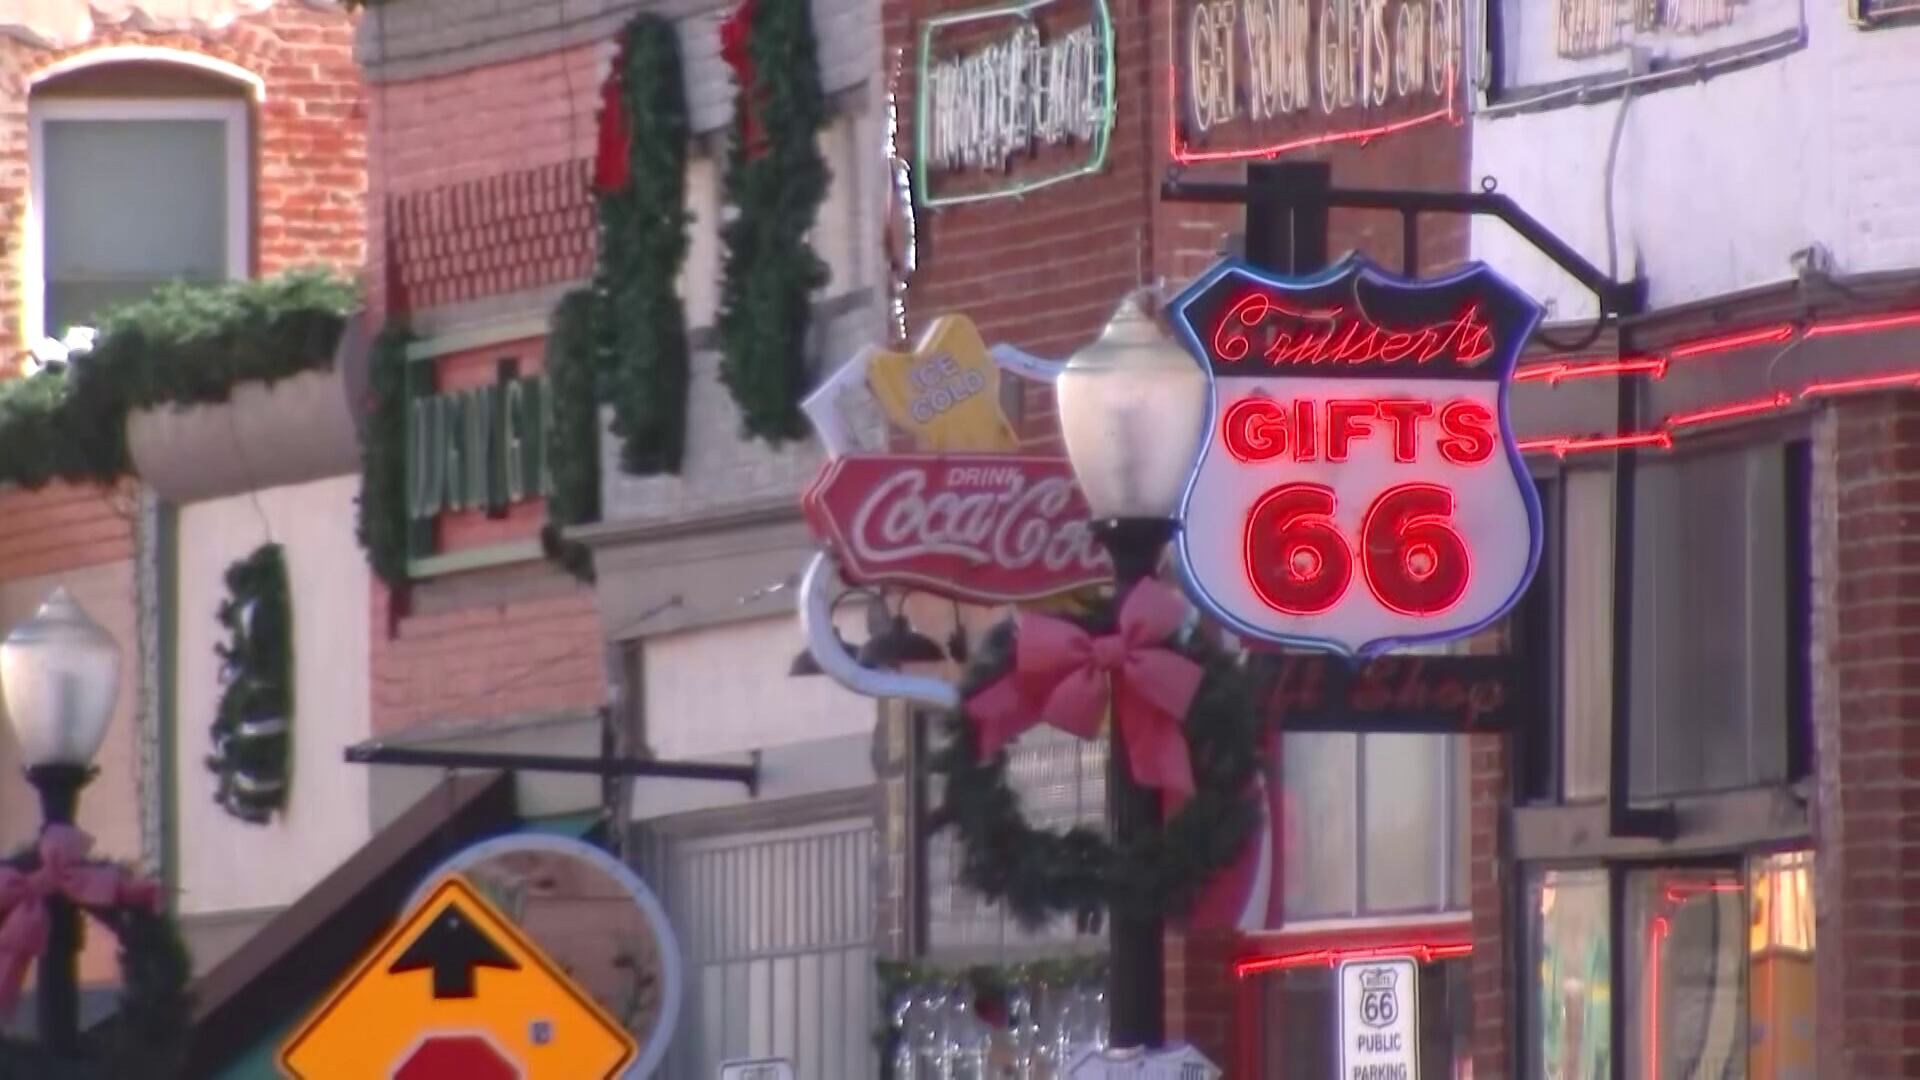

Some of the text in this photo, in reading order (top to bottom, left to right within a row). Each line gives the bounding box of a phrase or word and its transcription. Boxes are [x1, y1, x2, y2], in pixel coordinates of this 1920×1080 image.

[1190, 2, 1239, 131] GET
[1319, 0, 1391, 114] GIFTS
[911, 352, 960, 392] ICE
[911, 369, 984, 421] COLD
[1222, 399, 1497, 464] GIFTS
[1244, 481, 1473, 616] 66
[1364, 993, 1393, 1021] 66
[1357, 1033, 1402, 1053] PUBLIC
[1353, 1063, 1407, 1080] PARKING
